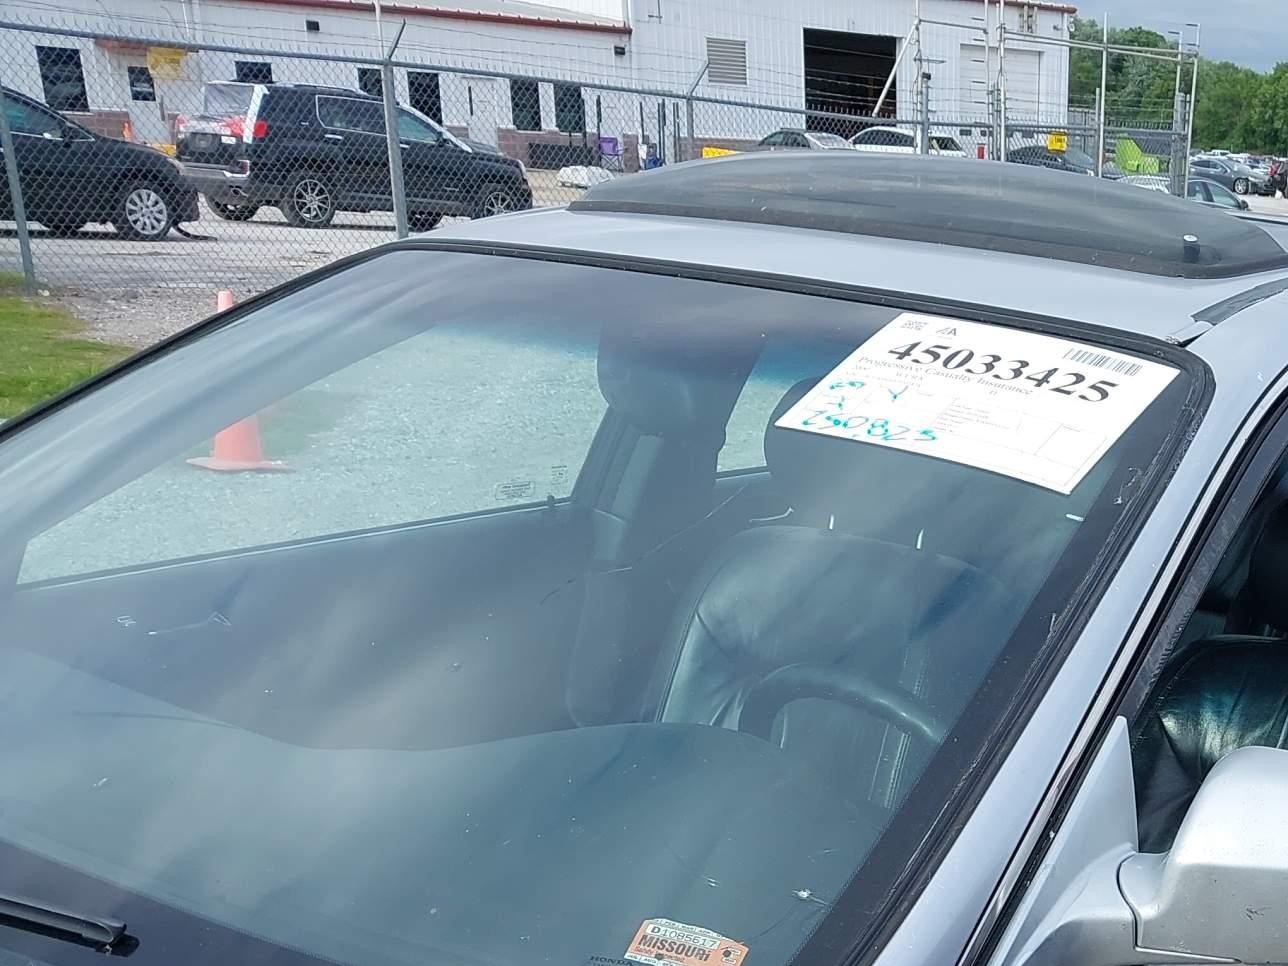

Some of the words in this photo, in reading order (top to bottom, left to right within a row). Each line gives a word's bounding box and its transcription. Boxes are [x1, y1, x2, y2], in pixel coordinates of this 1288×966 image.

[858, 356, 924, 372] Progressive
[924, 367, 972, 383] Casualty
[976, 377, 1034, 395] Insurance
[888, 341, 1119, 402] 45033425
[590, 955, 633, 966] HONDA
[637, 934, 711, 962] MISSOURI
